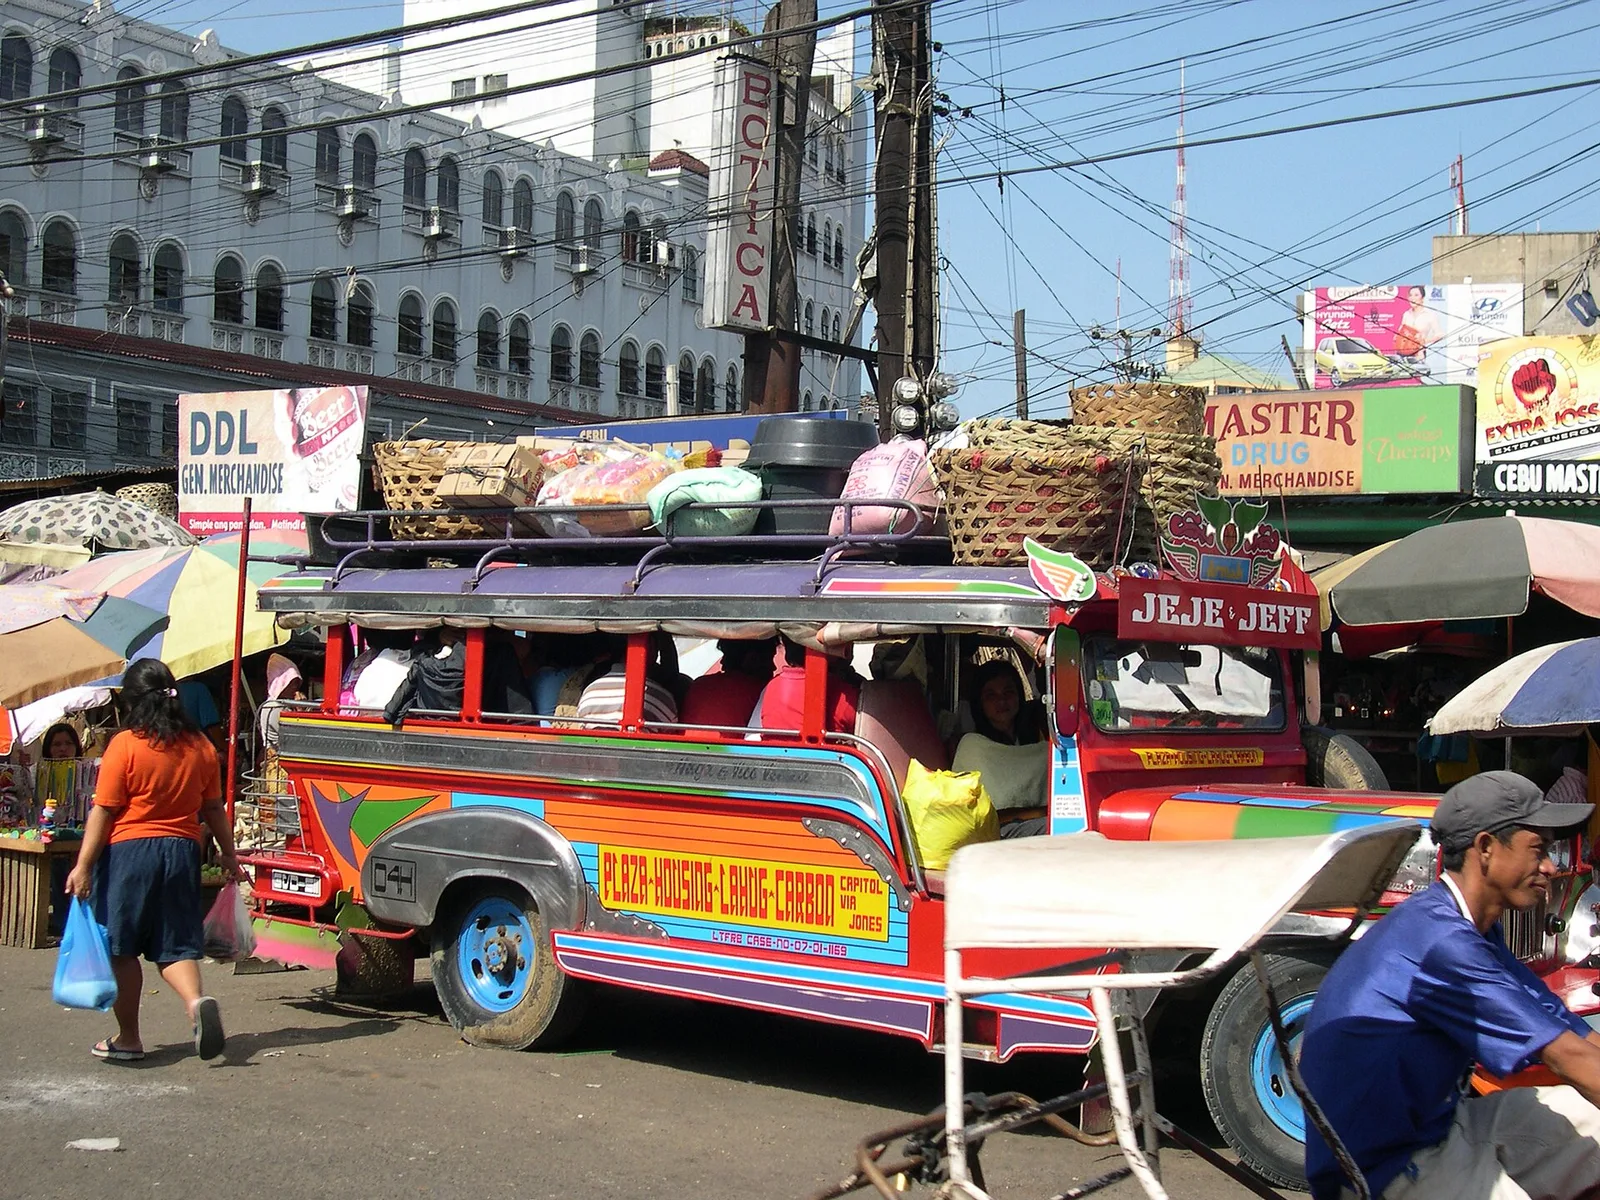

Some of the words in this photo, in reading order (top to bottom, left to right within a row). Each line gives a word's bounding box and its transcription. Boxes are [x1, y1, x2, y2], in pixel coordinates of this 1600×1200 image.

[731, 70, 773, 322] BOTICA
[190, 408, 258, 456] DDL
[300, 394, 346, 440] Beer
[1485, 414, 1547, 446] EXTRA
[1552, 402, 1600, 430] JOSS
[320, 426, 339, 445] NA
[1366, 437, 1457, 464] Therapy
[1495, 439, 1539, 455] EXTRA
[1543, 426, 1598, 444] ENERGY
[1231, 441, 1310, 467] DRUG
[181, 463, 207, 495] GEN.
[209, 462, 284, 495] MERCHANDISE
[1239, 470, 1354, 490] MERCHANDISE
[1494, 462, 1542, 494] CEBU
[1545, 462, 1600, 495] MAST
[189, 518, 213, 531] Simple
[213, 521, 228, 531] ang
[270, 518, 300, 530] Matindi
[1131, 592, 1225, 629] JEJE
[1238, 601, 1312, 635] JEFF
[374, 862, 413, 897] 04H
[604, 852, 648, 905] PLAZA
[654, 857, 714, 913] HOUSING
[719, 864, 768, 919] LAHUG
[775, 870, 835, 927] CARBON
[840, 875, 883, 895] CAPITOL
[840, 894, 857, 911] VIA
[849, 914, 883, 932] JONES
